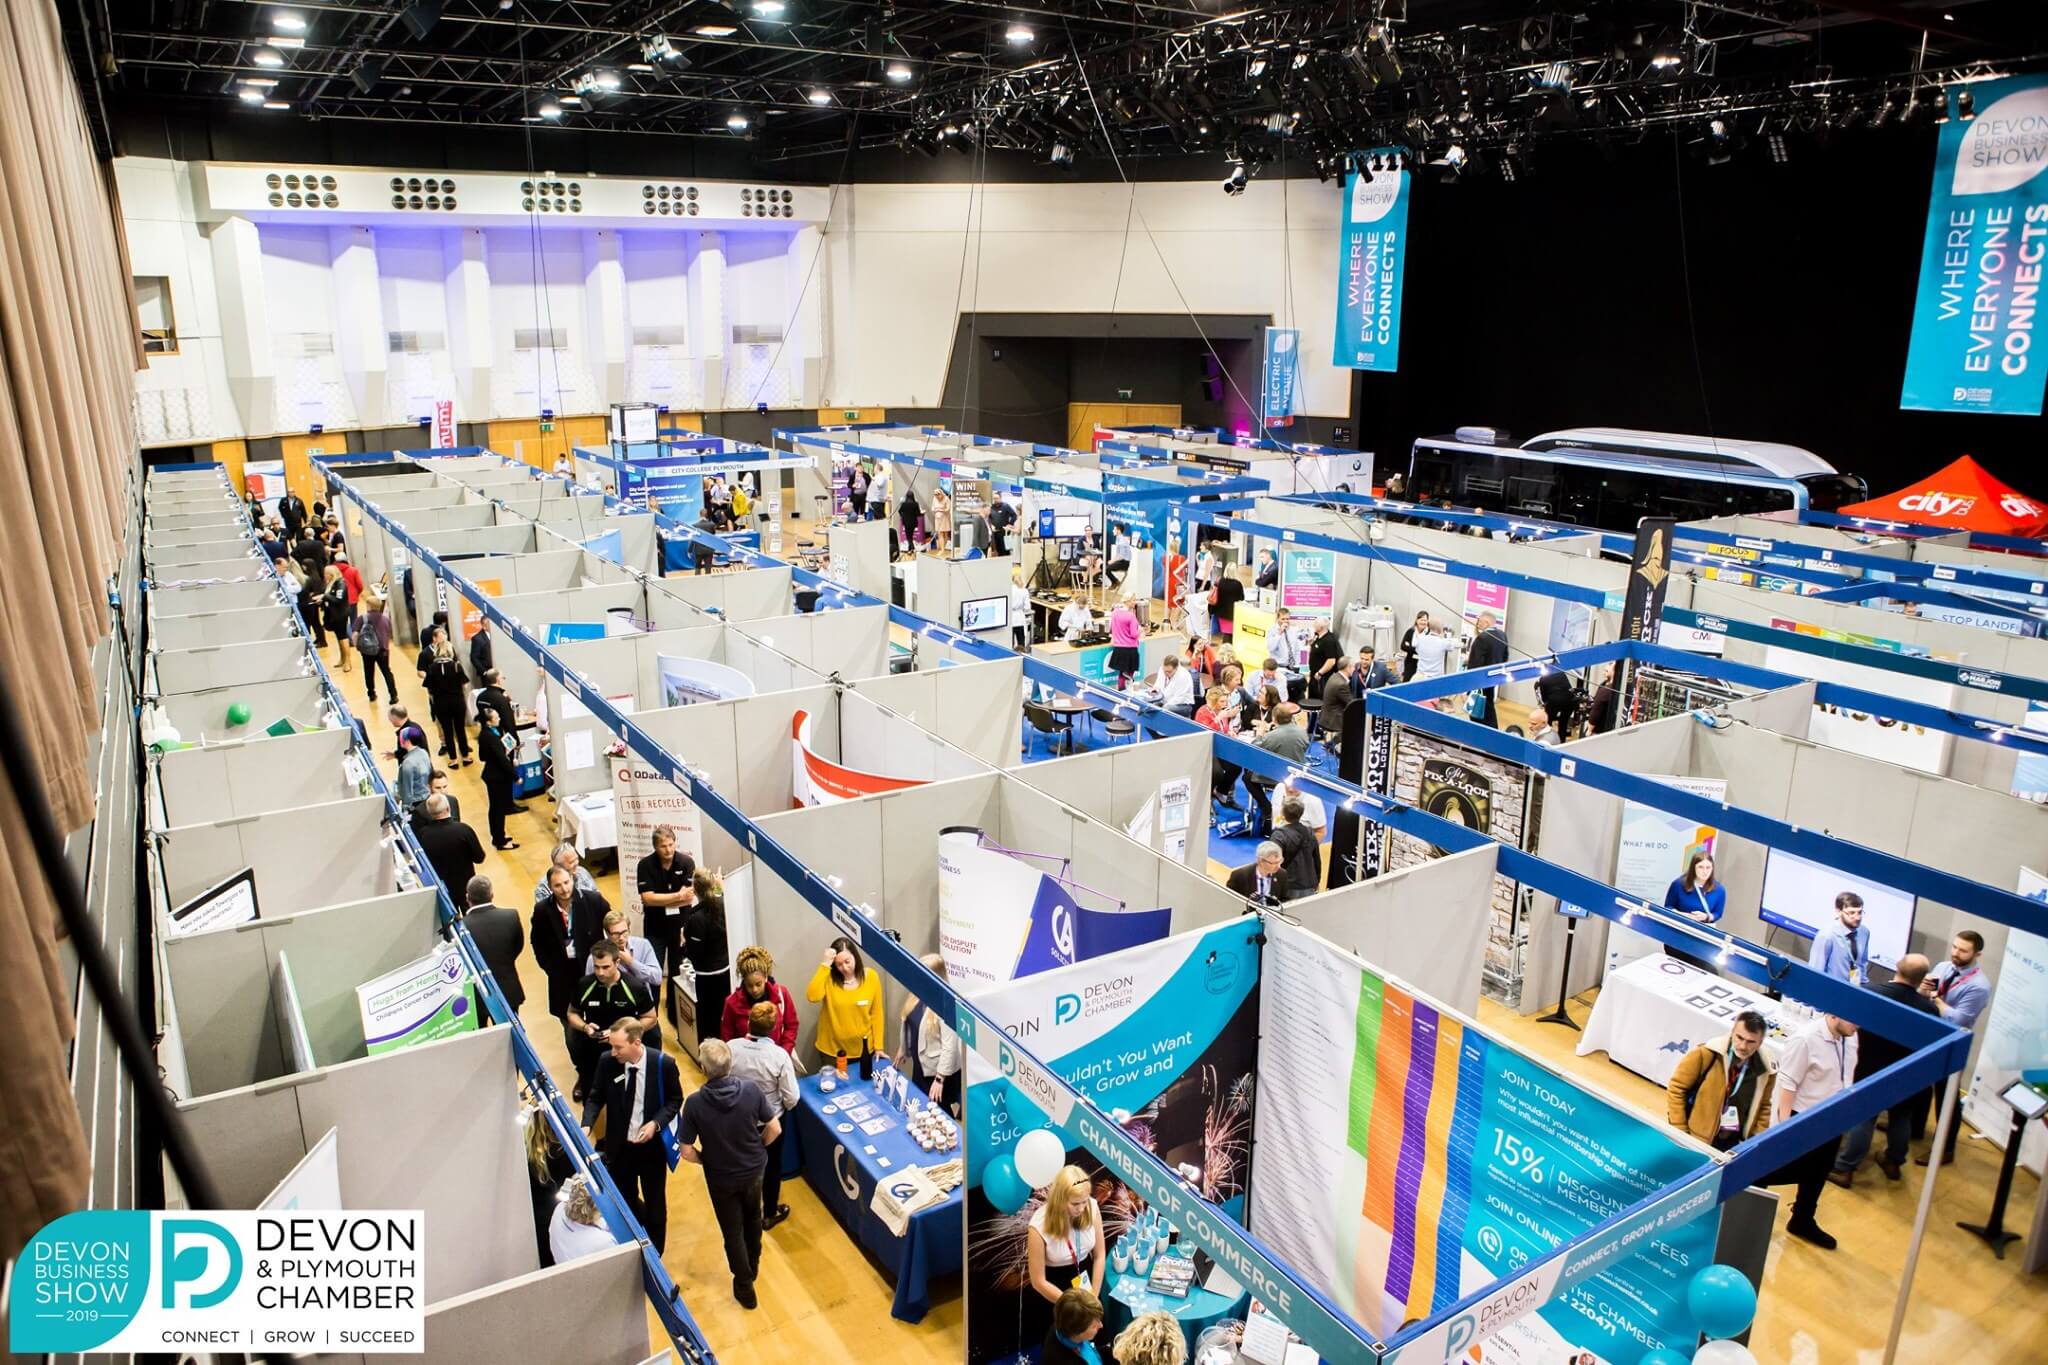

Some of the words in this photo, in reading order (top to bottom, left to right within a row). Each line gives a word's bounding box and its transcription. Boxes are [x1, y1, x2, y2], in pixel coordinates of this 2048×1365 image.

[1975, 114, 2048, 137] DEVON
[1972, 147, 2047, 168] SHOW
[1359, 192, 1393, 205] SHOW
[1348, 231, 1363, 307] WHERE
[1937, 207, 1976, 321] WHERE
[1361, 231, 1380, 343] EVERYONE
[1377, 231, 1396, 345] CONNECTS
[1964, 206, 2013, 373] EVERYONE
[2001, 203, 2048, 376] CONNECTS
[1271, 356, 1281, 411] ELECTRIC
[713, 464, 744, 472] PLYMOUTH
[955, 482, 976, 491] WIN!
[1899, 490, 1964, 516] city
[1942, 614, 1972, 625] STOP
[648, 798, 687, 809] RECYCLED
[950, 936, 977, 950] DISPUTE
[1084, 975, 1134, 999] DEVON
[1091, 988, 1133, 1007] PLYMOUTH
[1084, 997, 1132, 1018] CHAMBER
[960, 1020, 972, 1037] 71
[1118, 1045, 1147, 1067] You
[1152, 1031, 1193, 1055] Want
[1018, 1060, 1056, 1103] DEVON
[1096, 1070, 1140, 1093] Grow
[1144, 1055, 1174, 1077] and
[1500, 1069, 1530, 1092] JOIN
[1534, 1084, 1576, 1116] TODAY
[1498, 1098, 1517, 1114] most
[1517, 1106, 1556, 1138] influential
[1556, 1131, 1604, 1168] membership
[1552, 1118, 1568, 1133] you
[1568, 1127, 1589, 1145] want
[1590, 1137, 1600, 1152] to
[1600, 1145, 1611, 1158] be
[1610, 1153, 1628, 1171] part
[1628, 1163, 1638, 1176] of
[1639, 1172, 1657, 1186] the
[1493, 1127, 1546, 1185] 15%
[1079, 1118, 1154, 1194] CHAMBER
[1158, 1184, 1183, 1214] OF
[1185, 1209, 1293, 1315] COMMERCE
[1486, 1194, 1514, 1218] JOIN
[1516, 1212, 1564, 1249] ONLINE
[1564, 1240, 1619, 1278] CONNECT,
[1621, 1221, 1656, 1247] GROW
[1656, 1216, 1665, 1227] &
[1665, 1189, 1712, 1221] SUCCEED
[1480, 1277, 1540, 1323] DEVON
[1570, 1301, 1618, 1337] 220471
